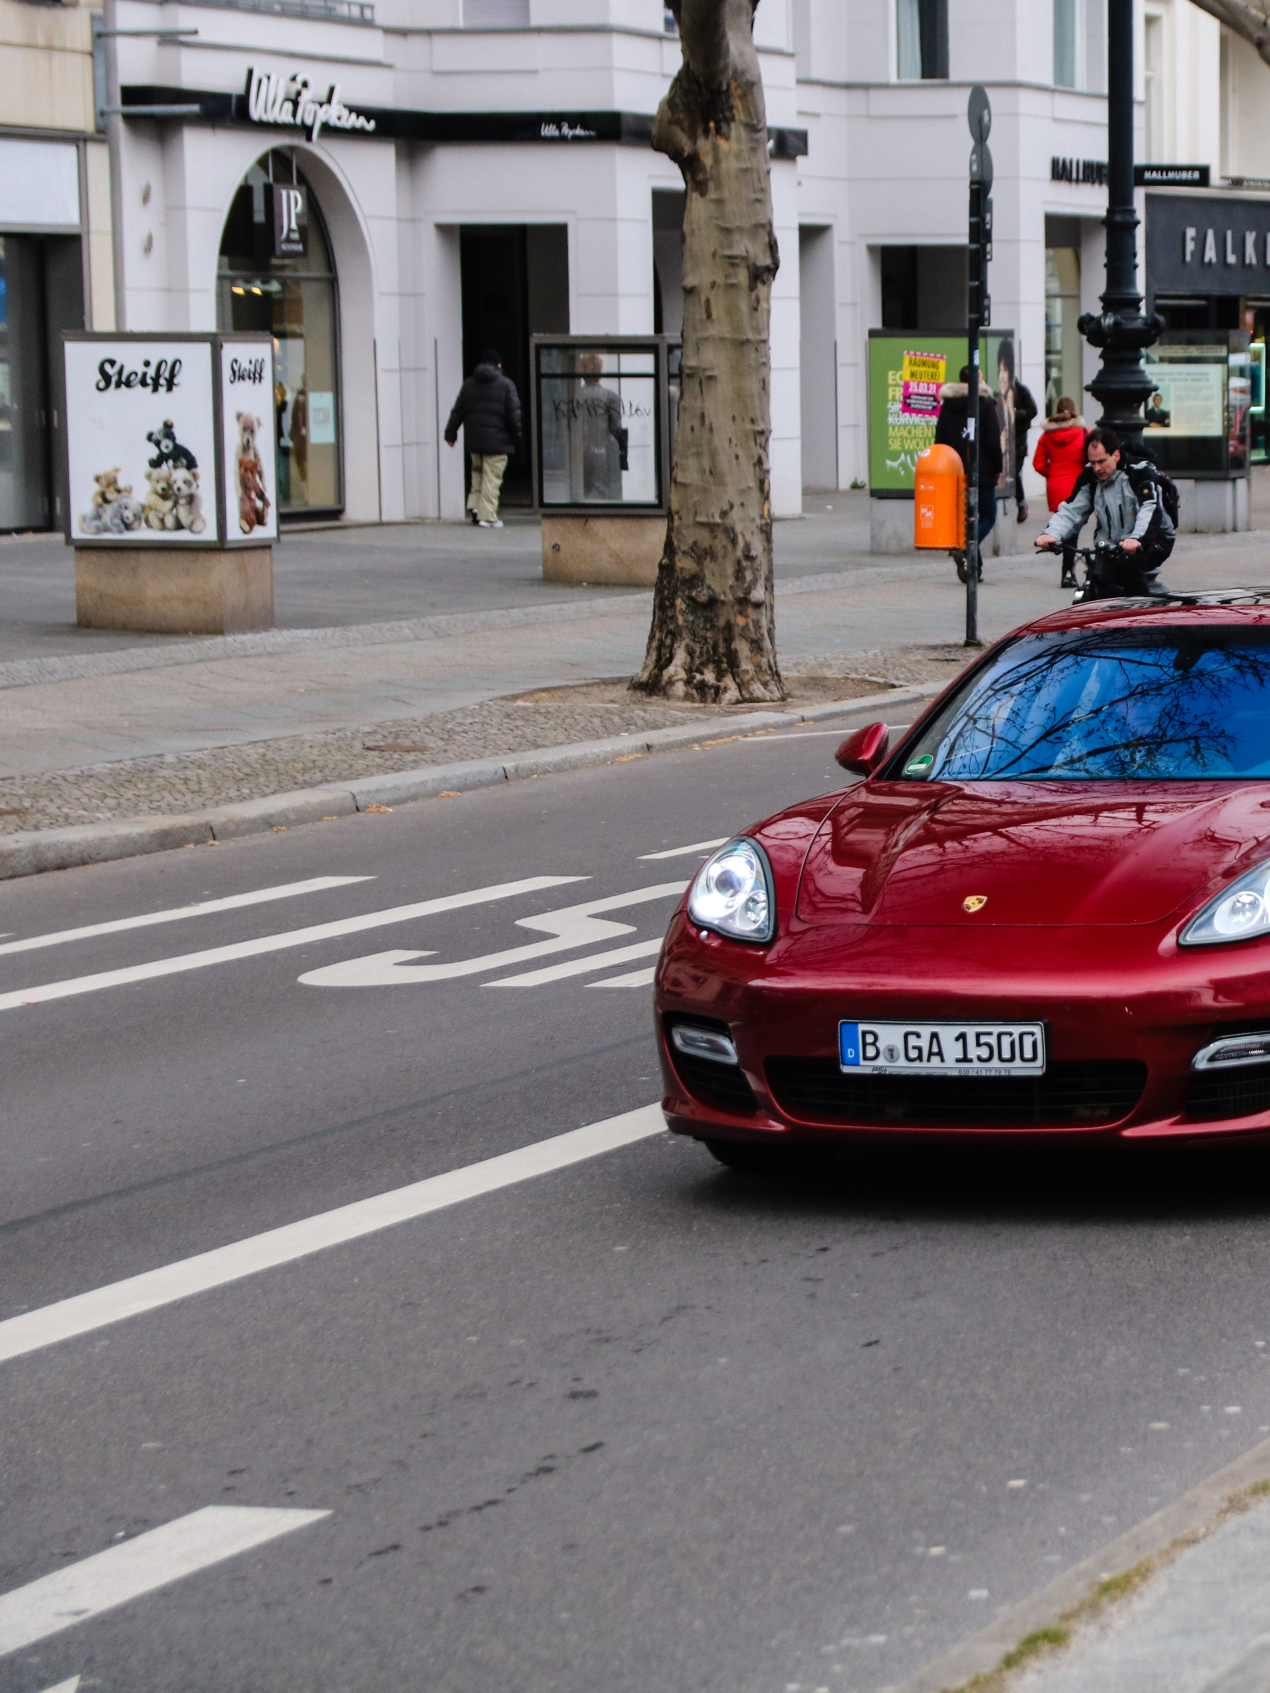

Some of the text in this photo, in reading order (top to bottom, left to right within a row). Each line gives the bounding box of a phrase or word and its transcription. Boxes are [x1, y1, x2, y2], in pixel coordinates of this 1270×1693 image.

[1143, 169, 1200, 180] HALLHUBER
[281, 188, 303, 241] JP
[95, 357, 182, 393] Steiff
[229, 356, 265, 385] Steiff
[888, 425, 932, 438] MACHEN
[847, 1029, 1038, 1063] D B GA 1500
